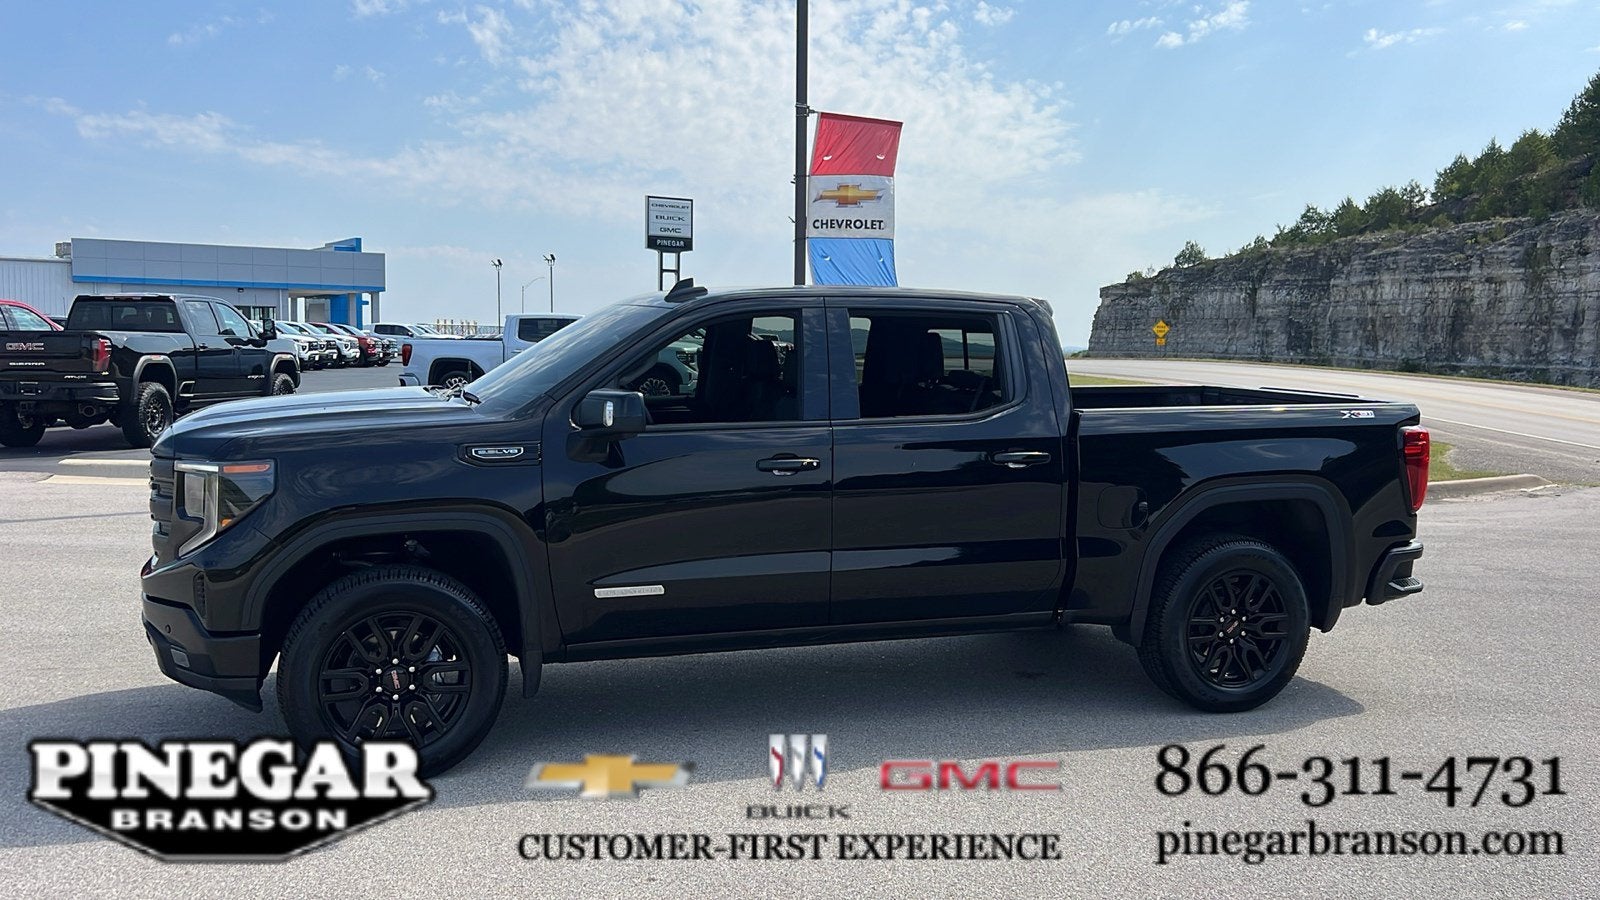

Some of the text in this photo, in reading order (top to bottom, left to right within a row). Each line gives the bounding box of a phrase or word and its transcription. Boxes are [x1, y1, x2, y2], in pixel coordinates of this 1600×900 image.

[651, 202, 690, 210] CHEVROLET
[655, 214, 686, 222] BUICK
[812, 218, 884, 231] CHEVROLET
[656, 239, 685, 248] PINEGAR
[5, 342, 45, 351] GMC
